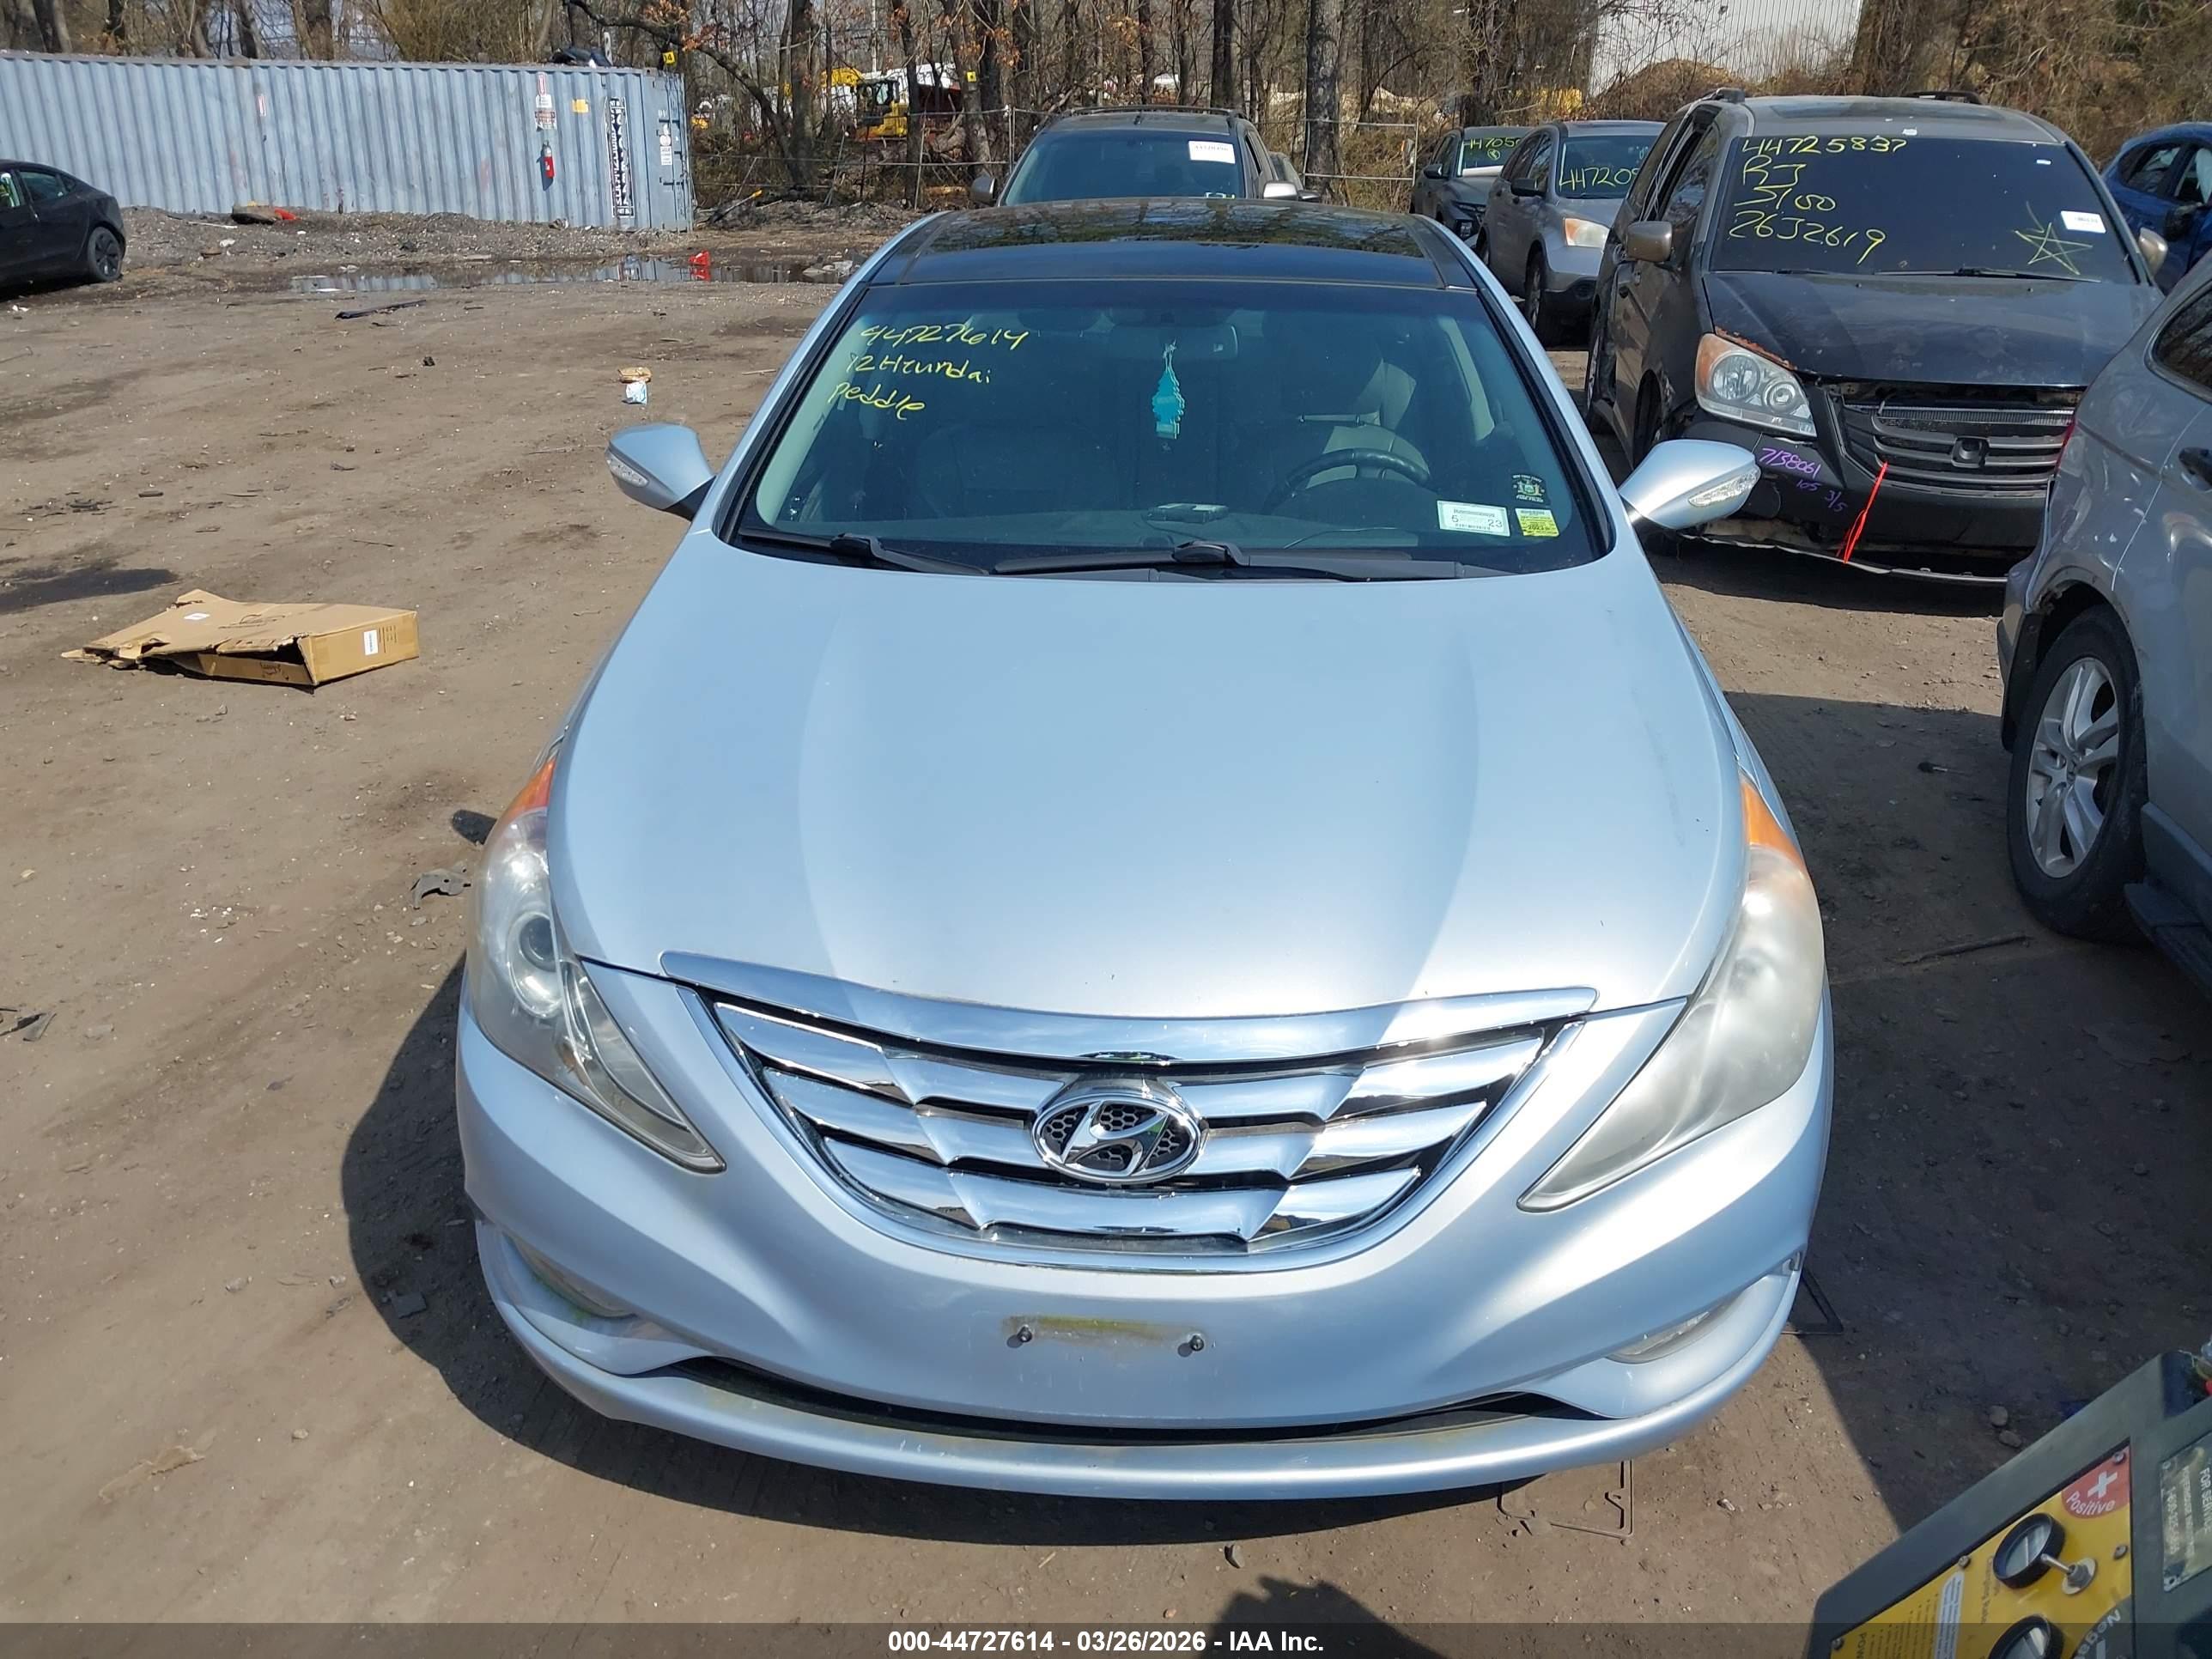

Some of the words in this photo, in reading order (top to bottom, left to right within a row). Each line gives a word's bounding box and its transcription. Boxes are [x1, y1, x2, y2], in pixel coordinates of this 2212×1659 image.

[1742, 136, 1907, 155] 44725837
[1759, 447, 1821, 479] 7138061
[1487, 519, 1503, 528] 23
[2066, 1491, 2116, 1515] Positive
